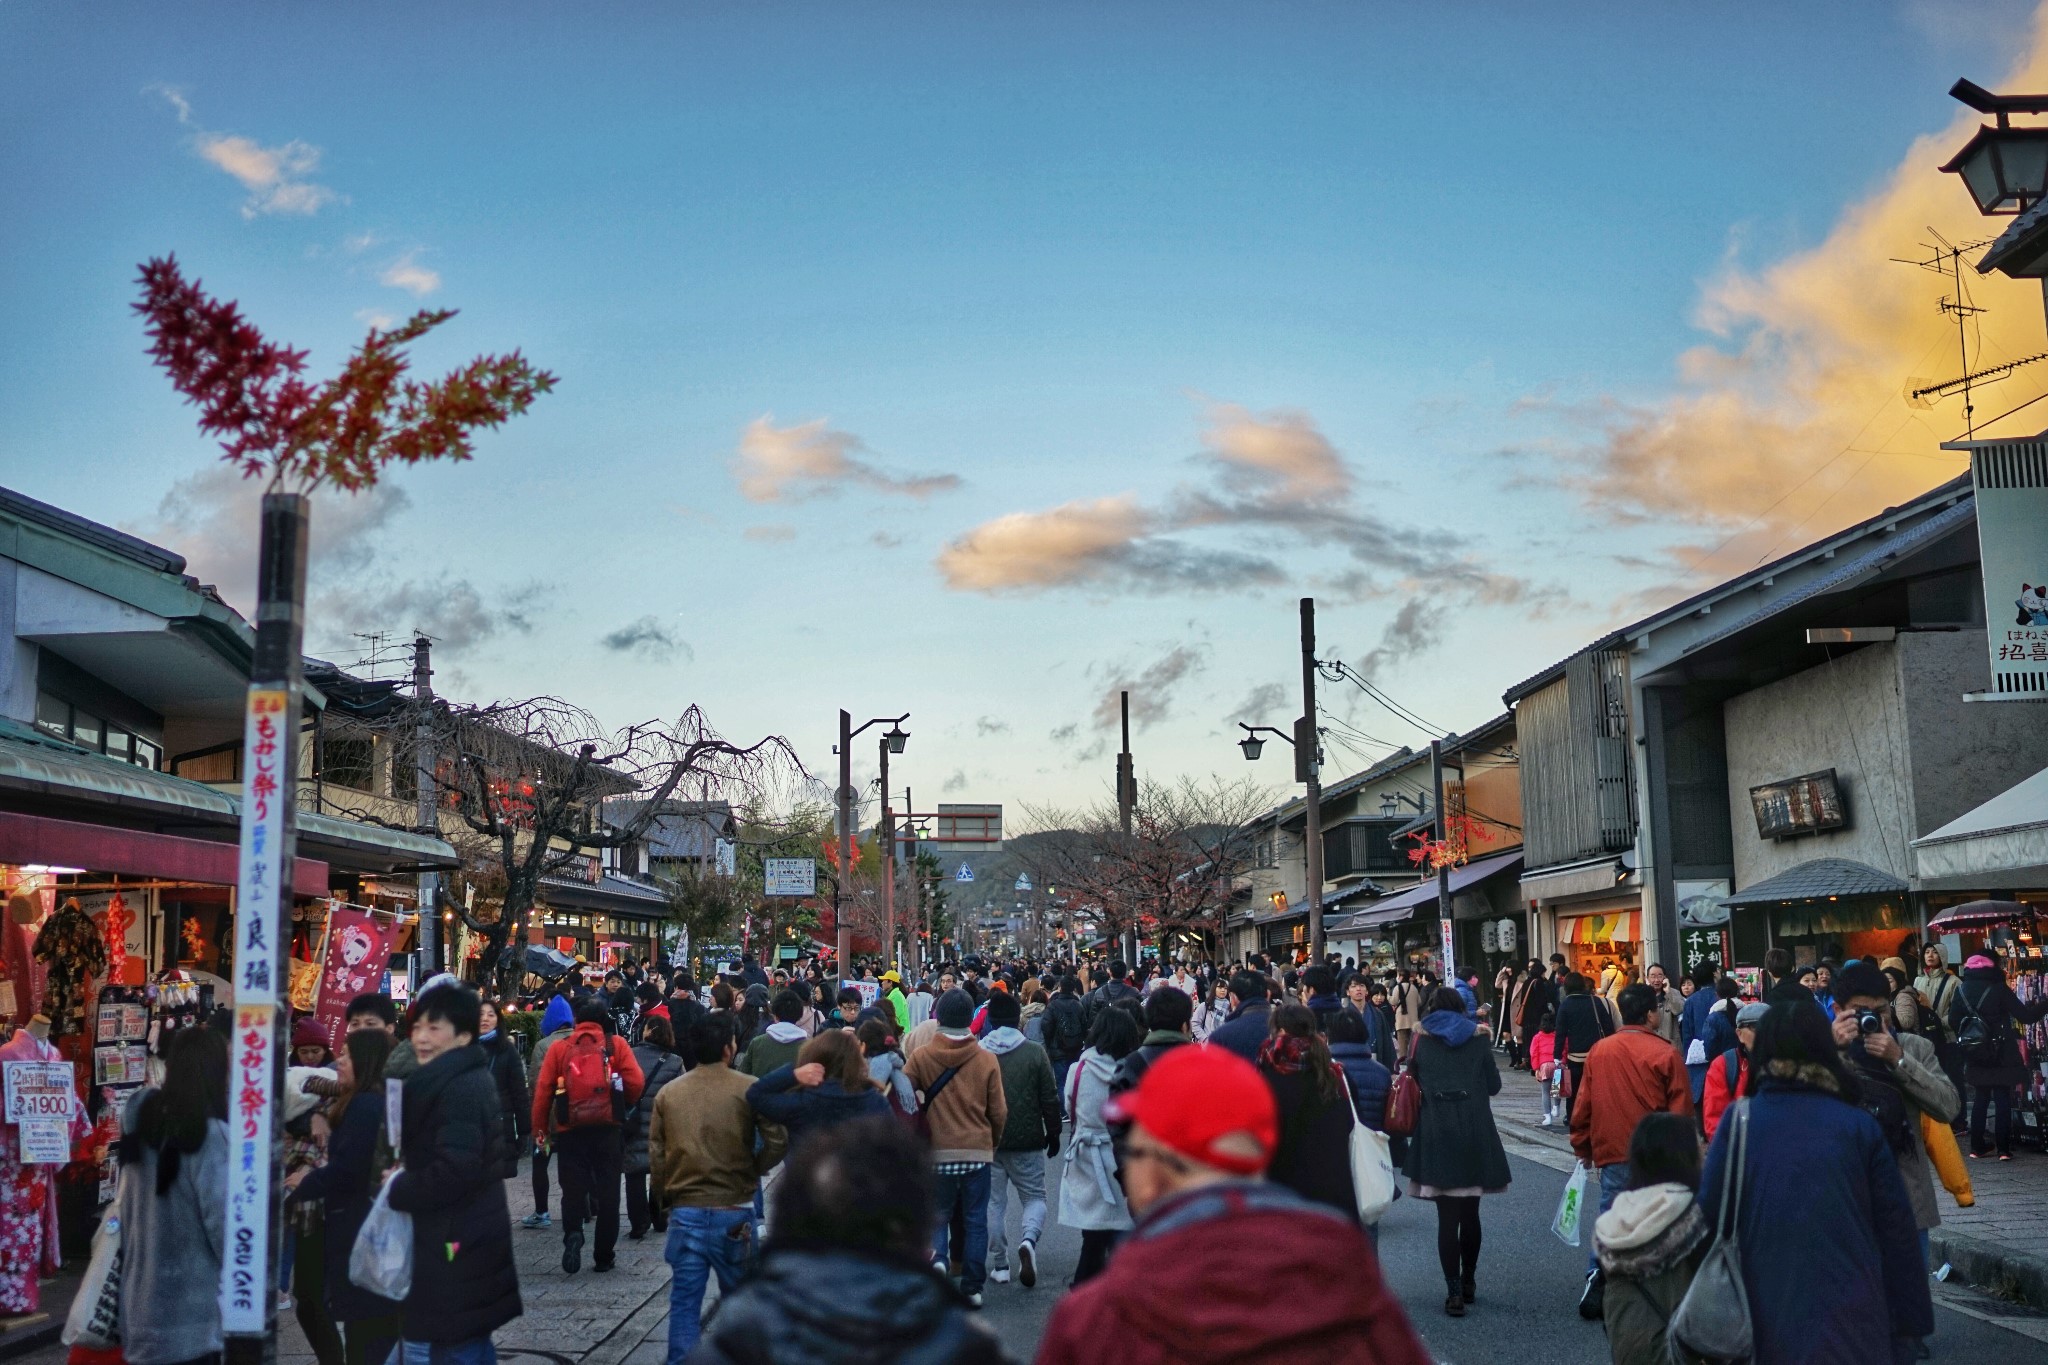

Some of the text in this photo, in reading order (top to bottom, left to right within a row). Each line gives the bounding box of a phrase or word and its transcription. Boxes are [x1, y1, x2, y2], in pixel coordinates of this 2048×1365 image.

[251, 716, 280, 822] もみじ祭り
[1686, 931, 1704, 974] 千枚
[1706, 931, 1722, 967] 西利
[31, 1096, 68, 1114] 1900
[238, 1031, 267, 1139] もみじ祭り
